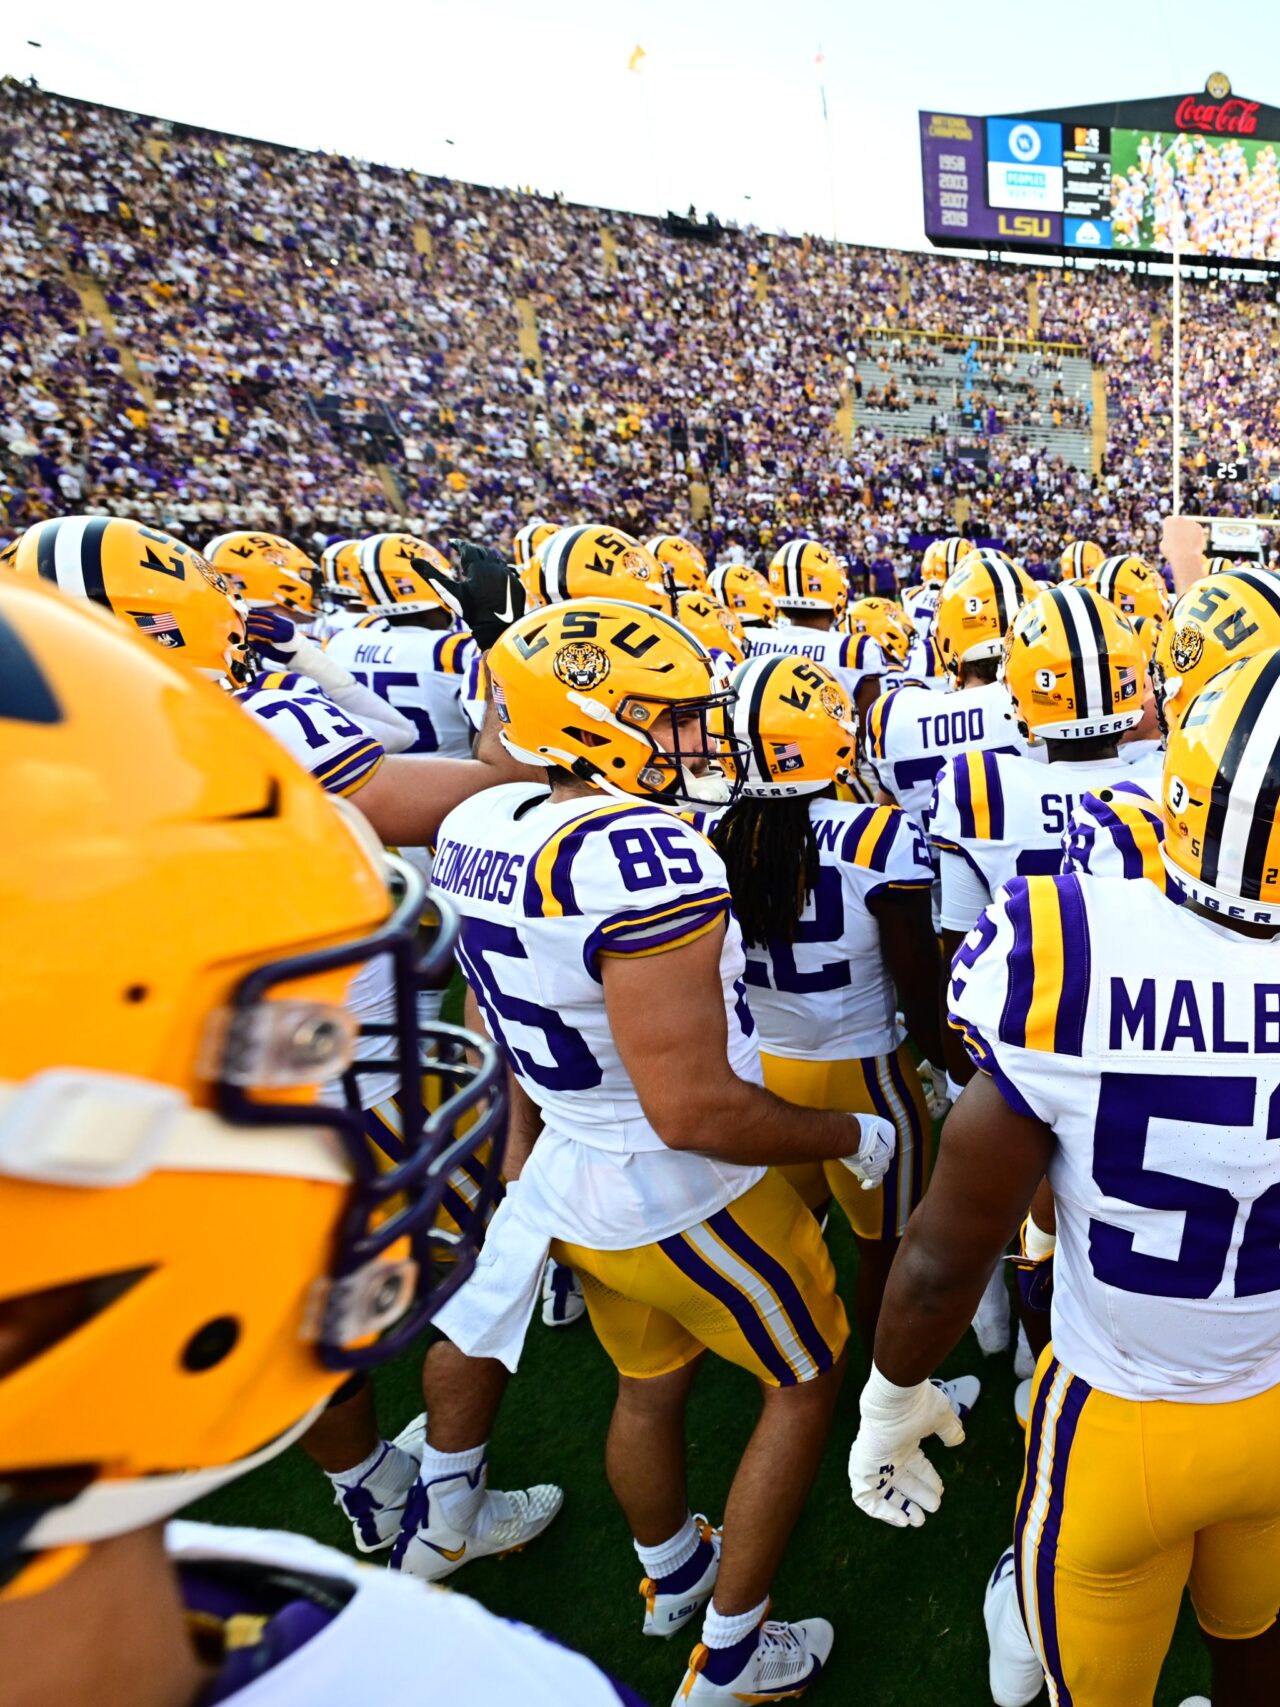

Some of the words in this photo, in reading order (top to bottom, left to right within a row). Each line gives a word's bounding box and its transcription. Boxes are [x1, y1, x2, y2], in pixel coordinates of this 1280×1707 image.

[998, 215, 1050, 238] LSU
[1217, 462, 1238, 479] 25
[970, 600, 977, 612] 3
[512, 611, 661, 660] LSU
[354, 644, 393, 664] HILL
[1041, 672, 1050, 688] 3
[1066, 698, 1074, 709] 3
[255, 697, 363, 749] 73
[917, 707, 985, 749] TODD
[1060, 717, 1134, 737] TIGERS
[1173, 782, 1184, 808] 3
[1191, 838, 1200, 858] 5
[608, 827, 704, 892] 85
[431, 838, 525, 905] LEONARDS
[1265, 868, 1279, 885] 2
[668, 1601, 698, 1622] LSU
